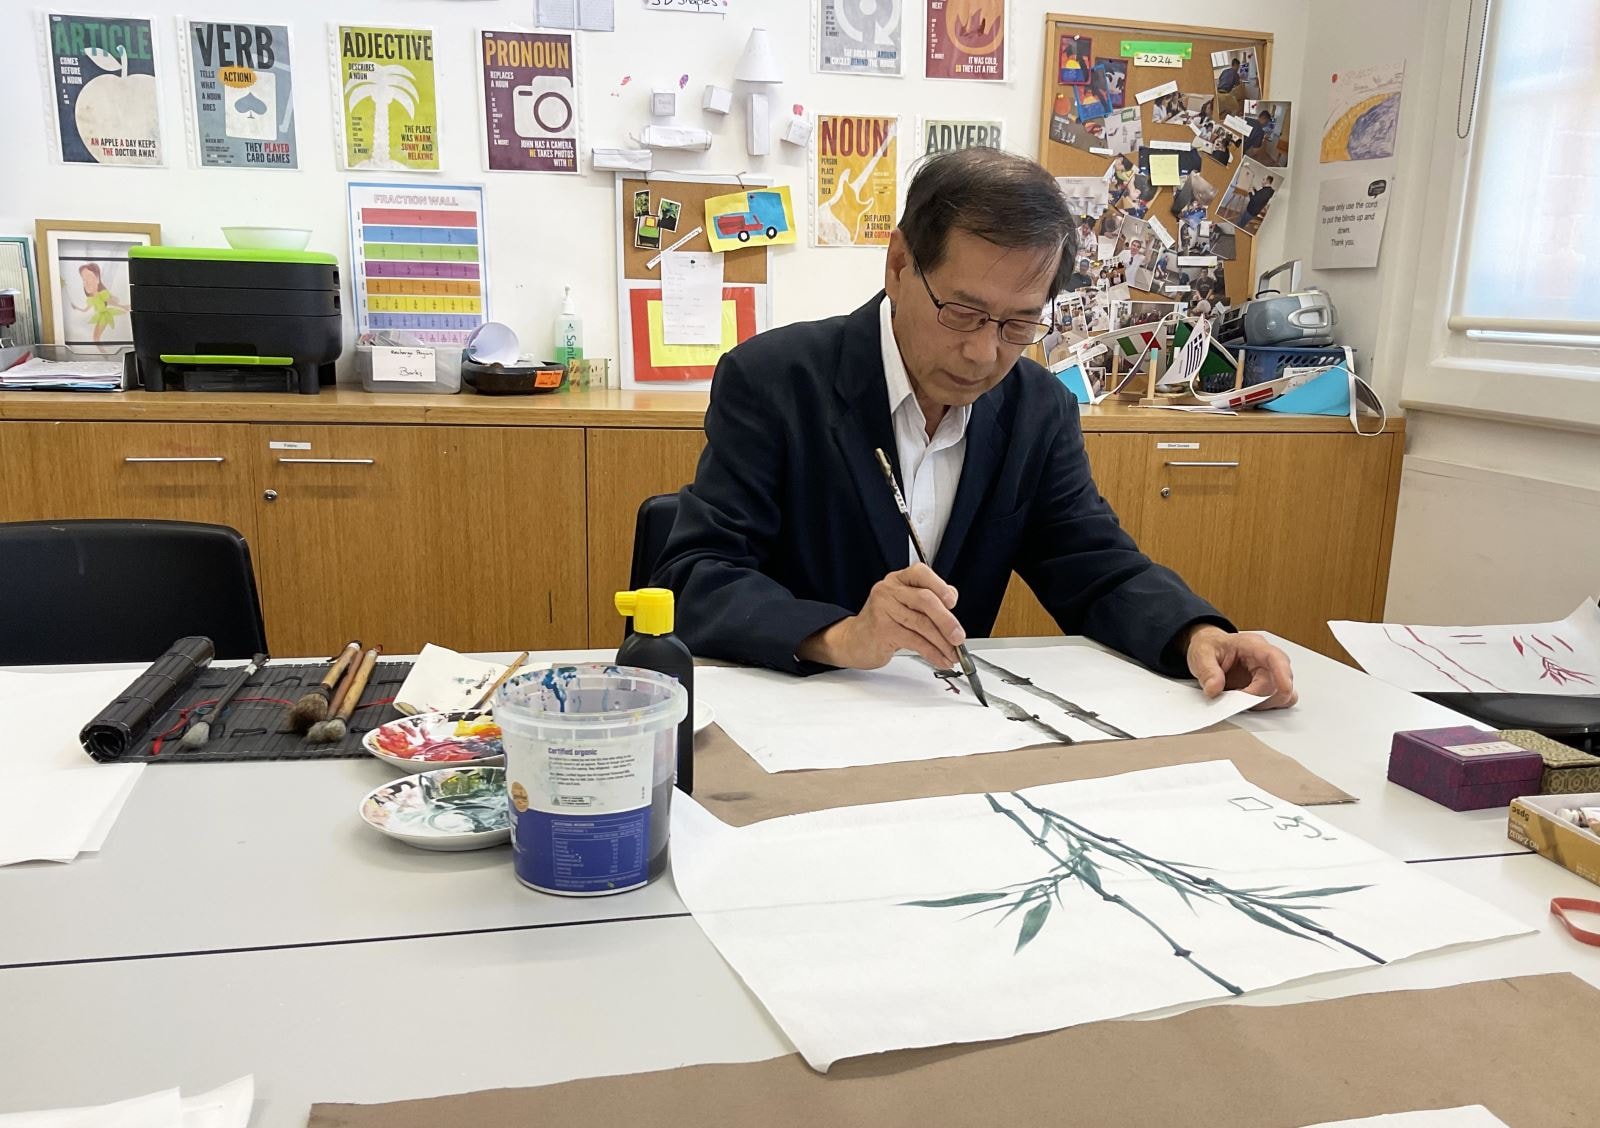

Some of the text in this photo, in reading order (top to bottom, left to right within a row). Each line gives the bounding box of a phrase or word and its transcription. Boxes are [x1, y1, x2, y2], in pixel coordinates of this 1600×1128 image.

[54, 22, 152, 59] ARTICLE
[195, 24, 275, 70] VERB
[343, 31, 434, 62] ADJECTIVE
[485, 39, 570, 69] PRONOUN
[968, 56, 974, 64] IT
[973, 57, 985, 65] WAS
[348, 62, 375, 72] DESCRIBES
[962, 65, 974, 73] THEY
[974, 65, 982, 73] LIT
[200, 69, 215, 79] TELLS
[223, 71, 253, 83] ACTION!
[348, 72, 354, 80] A
[490, 71, 514, 80] REPLACES
[62, 76, 67, 84] A
[490, 80, 495, 88] A
[201, 81, 216, 90] WHAT
[201, 92, 206, 100] A
[202, 103, 217, 112] DOES
[404, 124, 432, 135] THE PLACE
[91, 137, 156, 149] AN APPLE A DAY KEEPS
[401, 133, 414, 143] WAS
[822, 118, 889, 158] NOUN
[245, 142, 290, 154] THEY PLAYED
[422, 143, 433, 153] AND
[534, 140, 546, 149] HAS
[545, 140, 551, 149] A
[102, 147, 114, 156] THE
[114, 148, 138, 157] DOCTOR
[536, 150, 554, 158] TAKES
[554, 150, 575, 159] PHOTOS
[246, 153, 265, 164] CARD
[266, 154, 291, 164] GAMES
[553, 159, 568, 167] WITH
[373, 193, 460, 207] FRACTION WALL
[864, 214, 891, 222] SHE PLAYED
[1356, 214, 1364, 222] up
[1364, 212, 1376, 221] and
[866, 222, 891, 230] A SONG ON
[864, 231, 873, 239] HER
[1331, 239, 1344, 247] Thank
[548, 747, 598, 757] Certified organic
